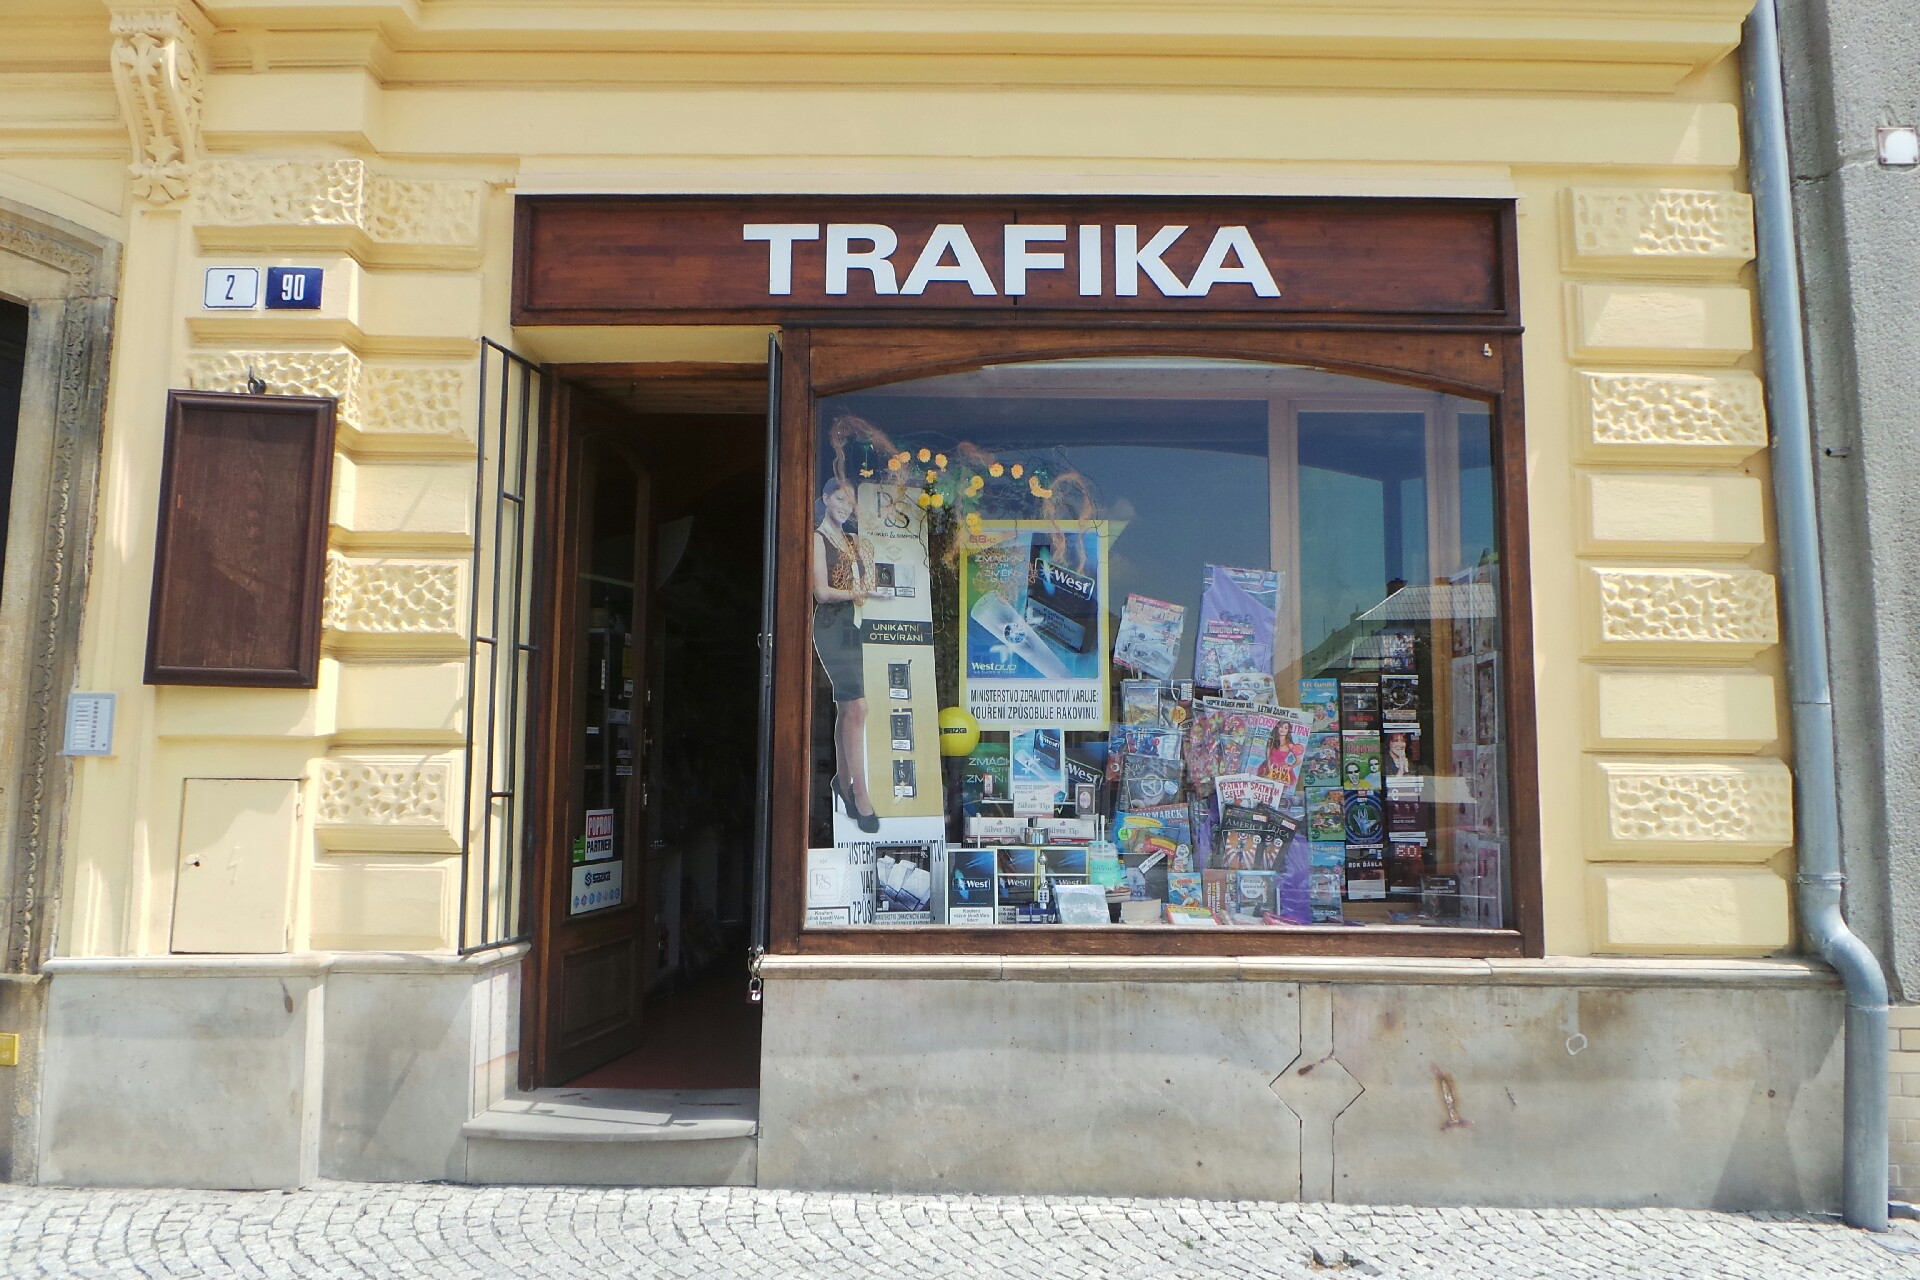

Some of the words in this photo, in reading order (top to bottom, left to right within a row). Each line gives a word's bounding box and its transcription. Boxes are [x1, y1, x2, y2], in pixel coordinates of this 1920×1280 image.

[743, 223, 1281, 297] TRAFIKA
[225, 274, 236, 301] 2
[281, 274, 306, 301] 90
[1054, 569, 1092, 595] West
[872, 623, 920, 632] UNIKÁTNÍ
[869, 632, 924, 642] OTEVÍRÁNÍ
[971, 662, 995, 670] West
[971, 689, 1019, 703] MINISTERSTVO
[1020, 687, 1070, 703] ZDRAVOTNICTVÍ
[1072, 690, 1099, 703] VARUJE:
[970, 703, 1006, 719] KOUŘENÍ
[1008, 703, 1053, 719] ZPŮSOBUJE
[1056, 706, 1099, 719] RAKOVINU.
[1258, 704, 1273, 714] LETNÍ
[1066, 762, 1100, 785] West
[1039, 802, 1051, 810] Tip
[983, 826, 1003, 834] Silver
[1003, 826, 1016, 835] Tip
[1068, 828, 1080, 836] Tip
[586, 838, 612, 854] PARTNER
[966, 880, 988, 888] West
[1006, 878, 1029, 887] West
